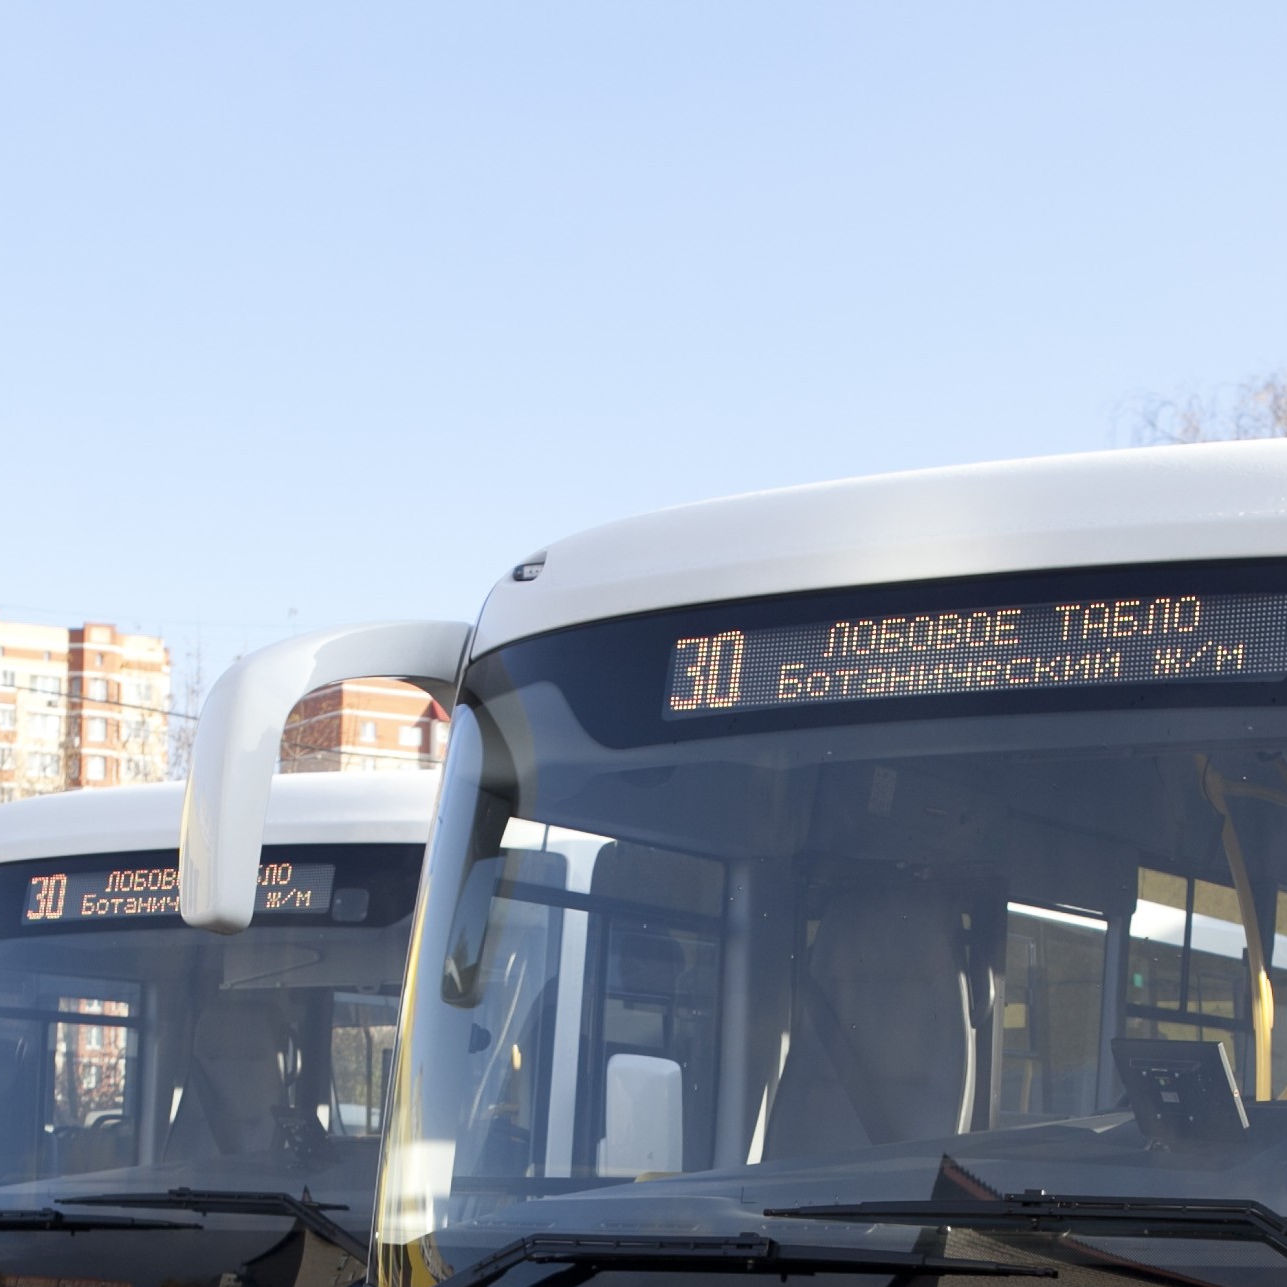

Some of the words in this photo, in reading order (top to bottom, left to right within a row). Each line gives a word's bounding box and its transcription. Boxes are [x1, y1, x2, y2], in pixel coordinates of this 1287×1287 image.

[823, 608, 1022, 658] ЛОБОВОЕ
[1054, 595, 1202, 641] ТАБЛО
[669, 629, 745, 711] 30
[26, 872, 68, 920] 30
[104, 868, 180, 893] ЛОБОВ
[256, 862, 293, 886] ЛО
[81, 892, 180, 916] Ботанич
